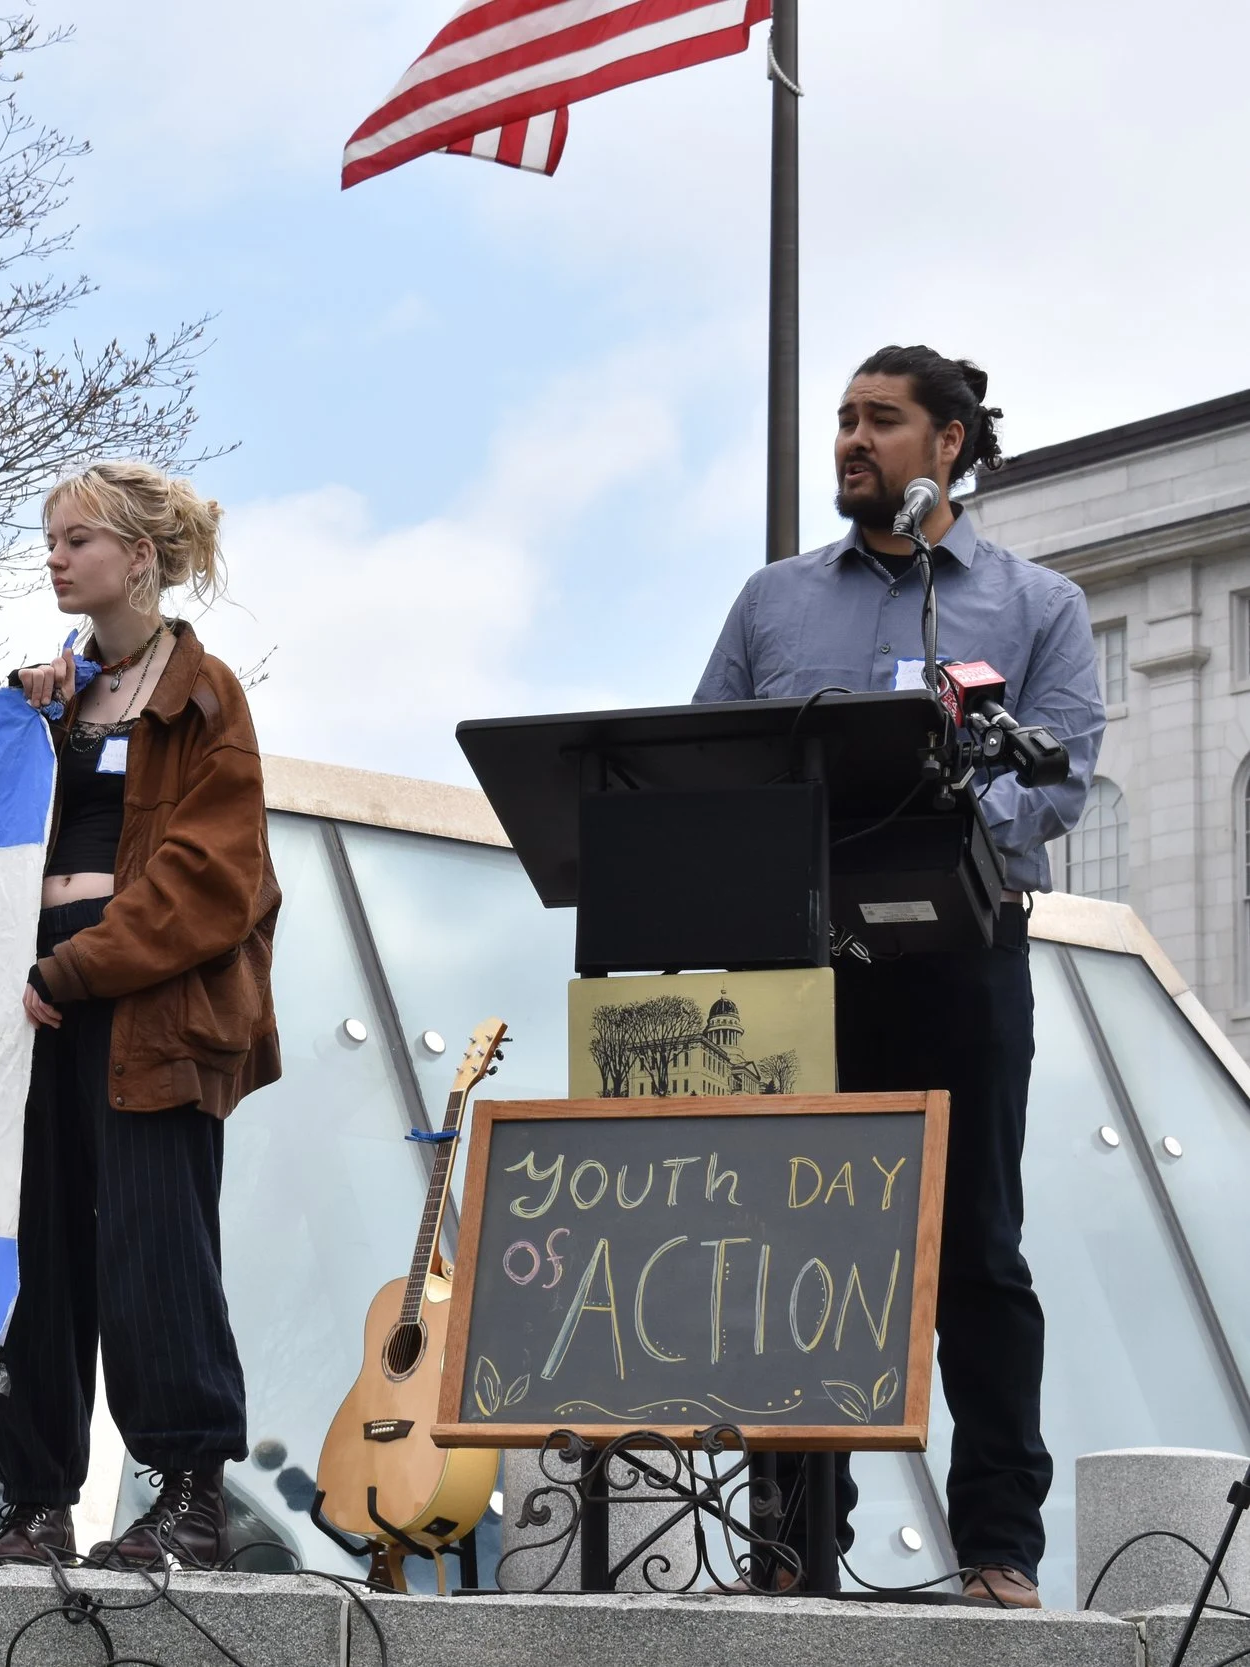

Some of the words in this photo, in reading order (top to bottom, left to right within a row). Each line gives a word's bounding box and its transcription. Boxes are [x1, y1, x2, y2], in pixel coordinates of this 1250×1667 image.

[788, 1156, 906, 1210] DAY
[502, 1228, 570, 1289] of
[540, 1235, 901, 1381] ACTION
